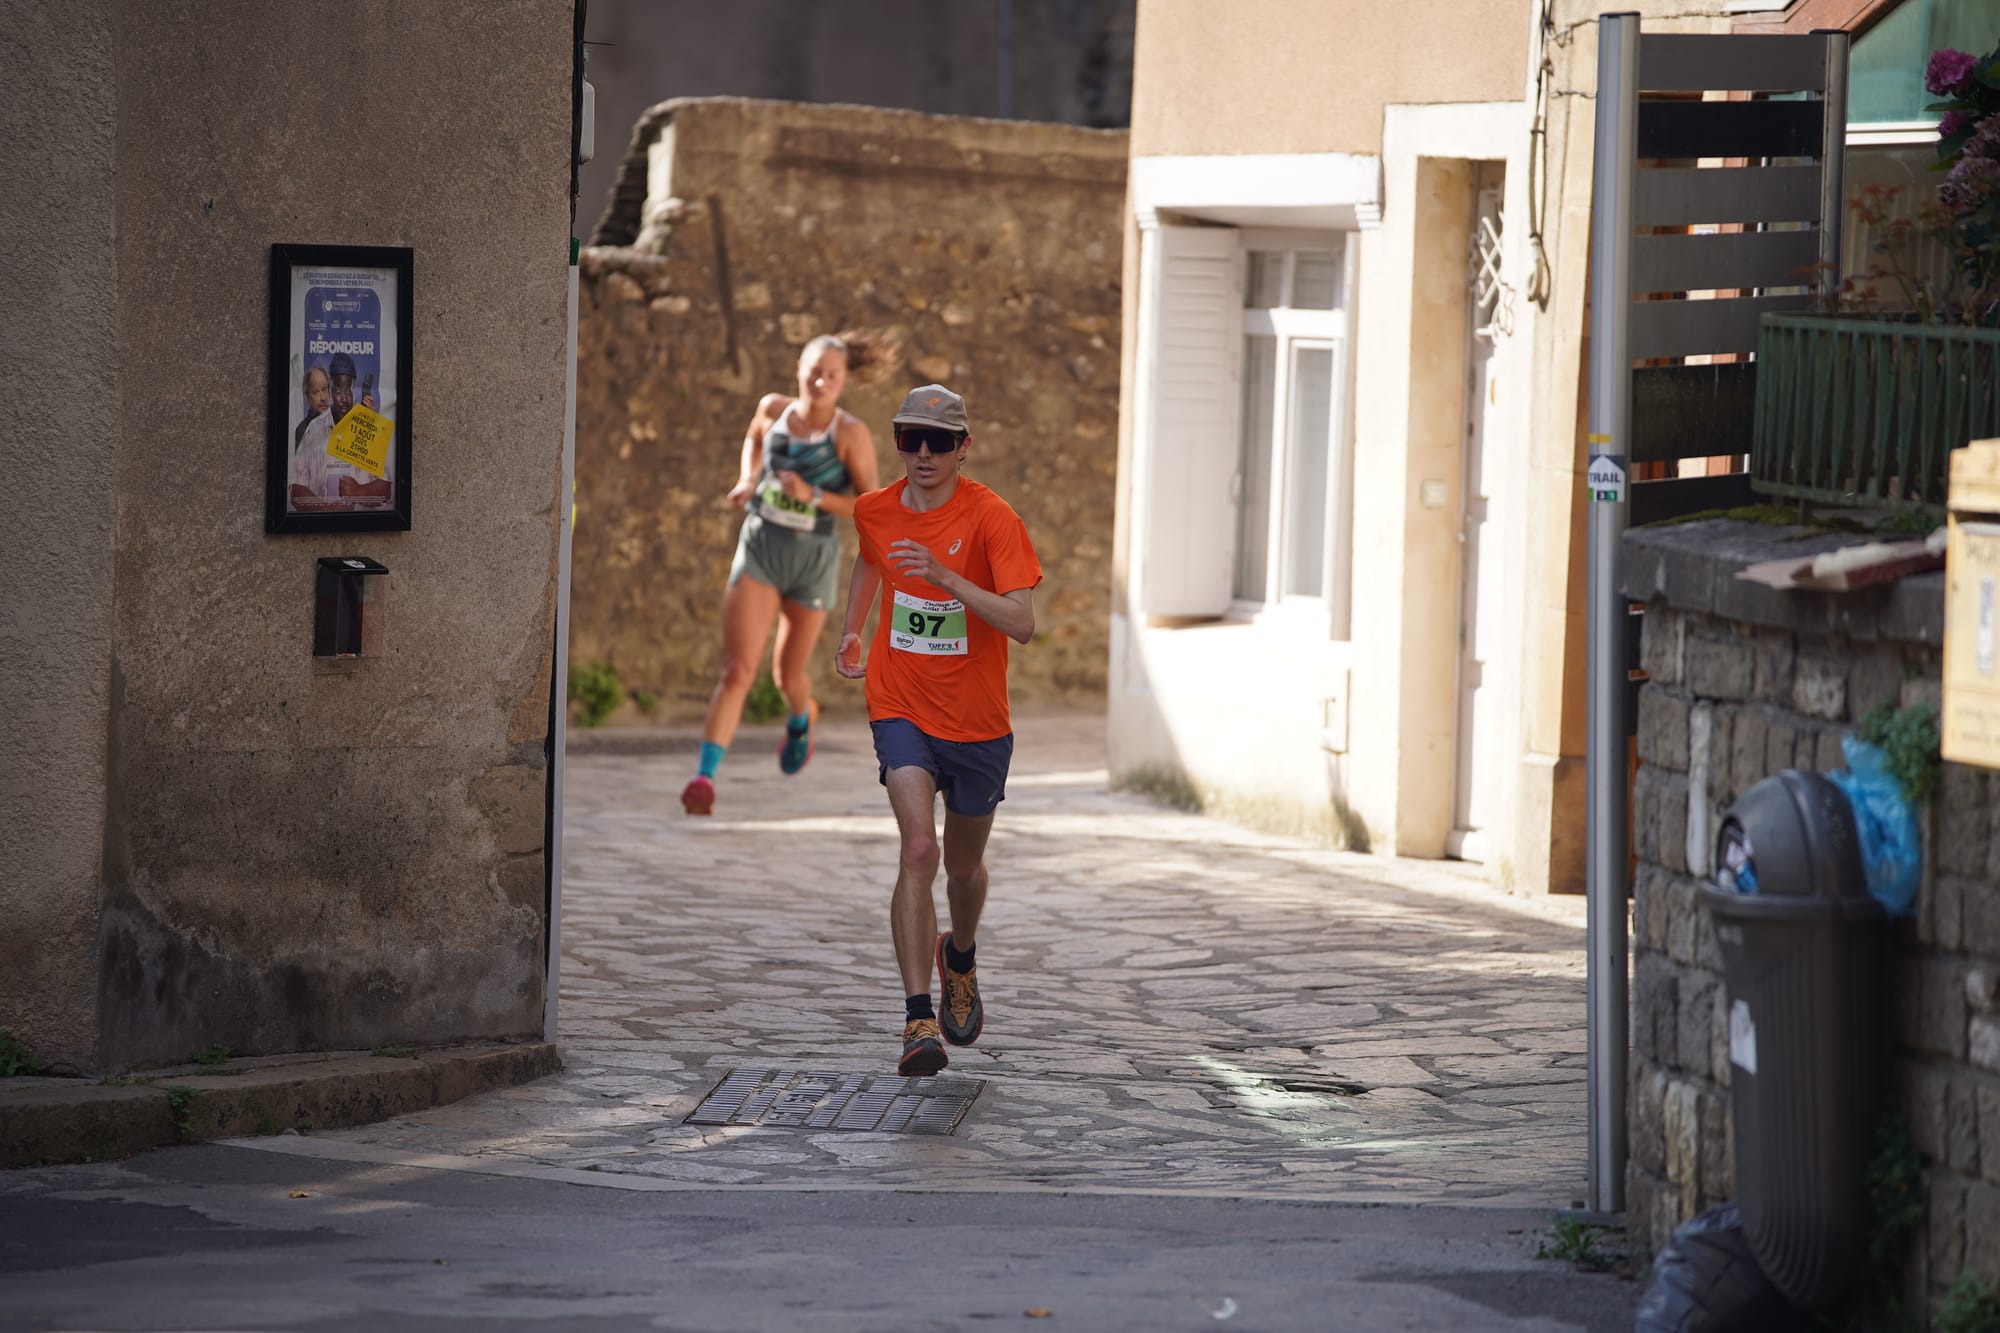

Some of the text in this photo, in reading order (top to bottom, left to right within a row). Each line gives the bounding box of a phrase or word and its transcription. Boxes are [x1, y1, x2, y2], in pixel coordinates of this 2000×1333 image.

[310, 340, 374, 354] RÉPONDEUR
[352, 416, 378, 432] MERCREDI
[354, 435, 368, 446] 2025
[358, 428, 376, 442] AOÛT
[1589, 472, 1621, 483] TRAIL
[909, 612, 946, 637] 97
